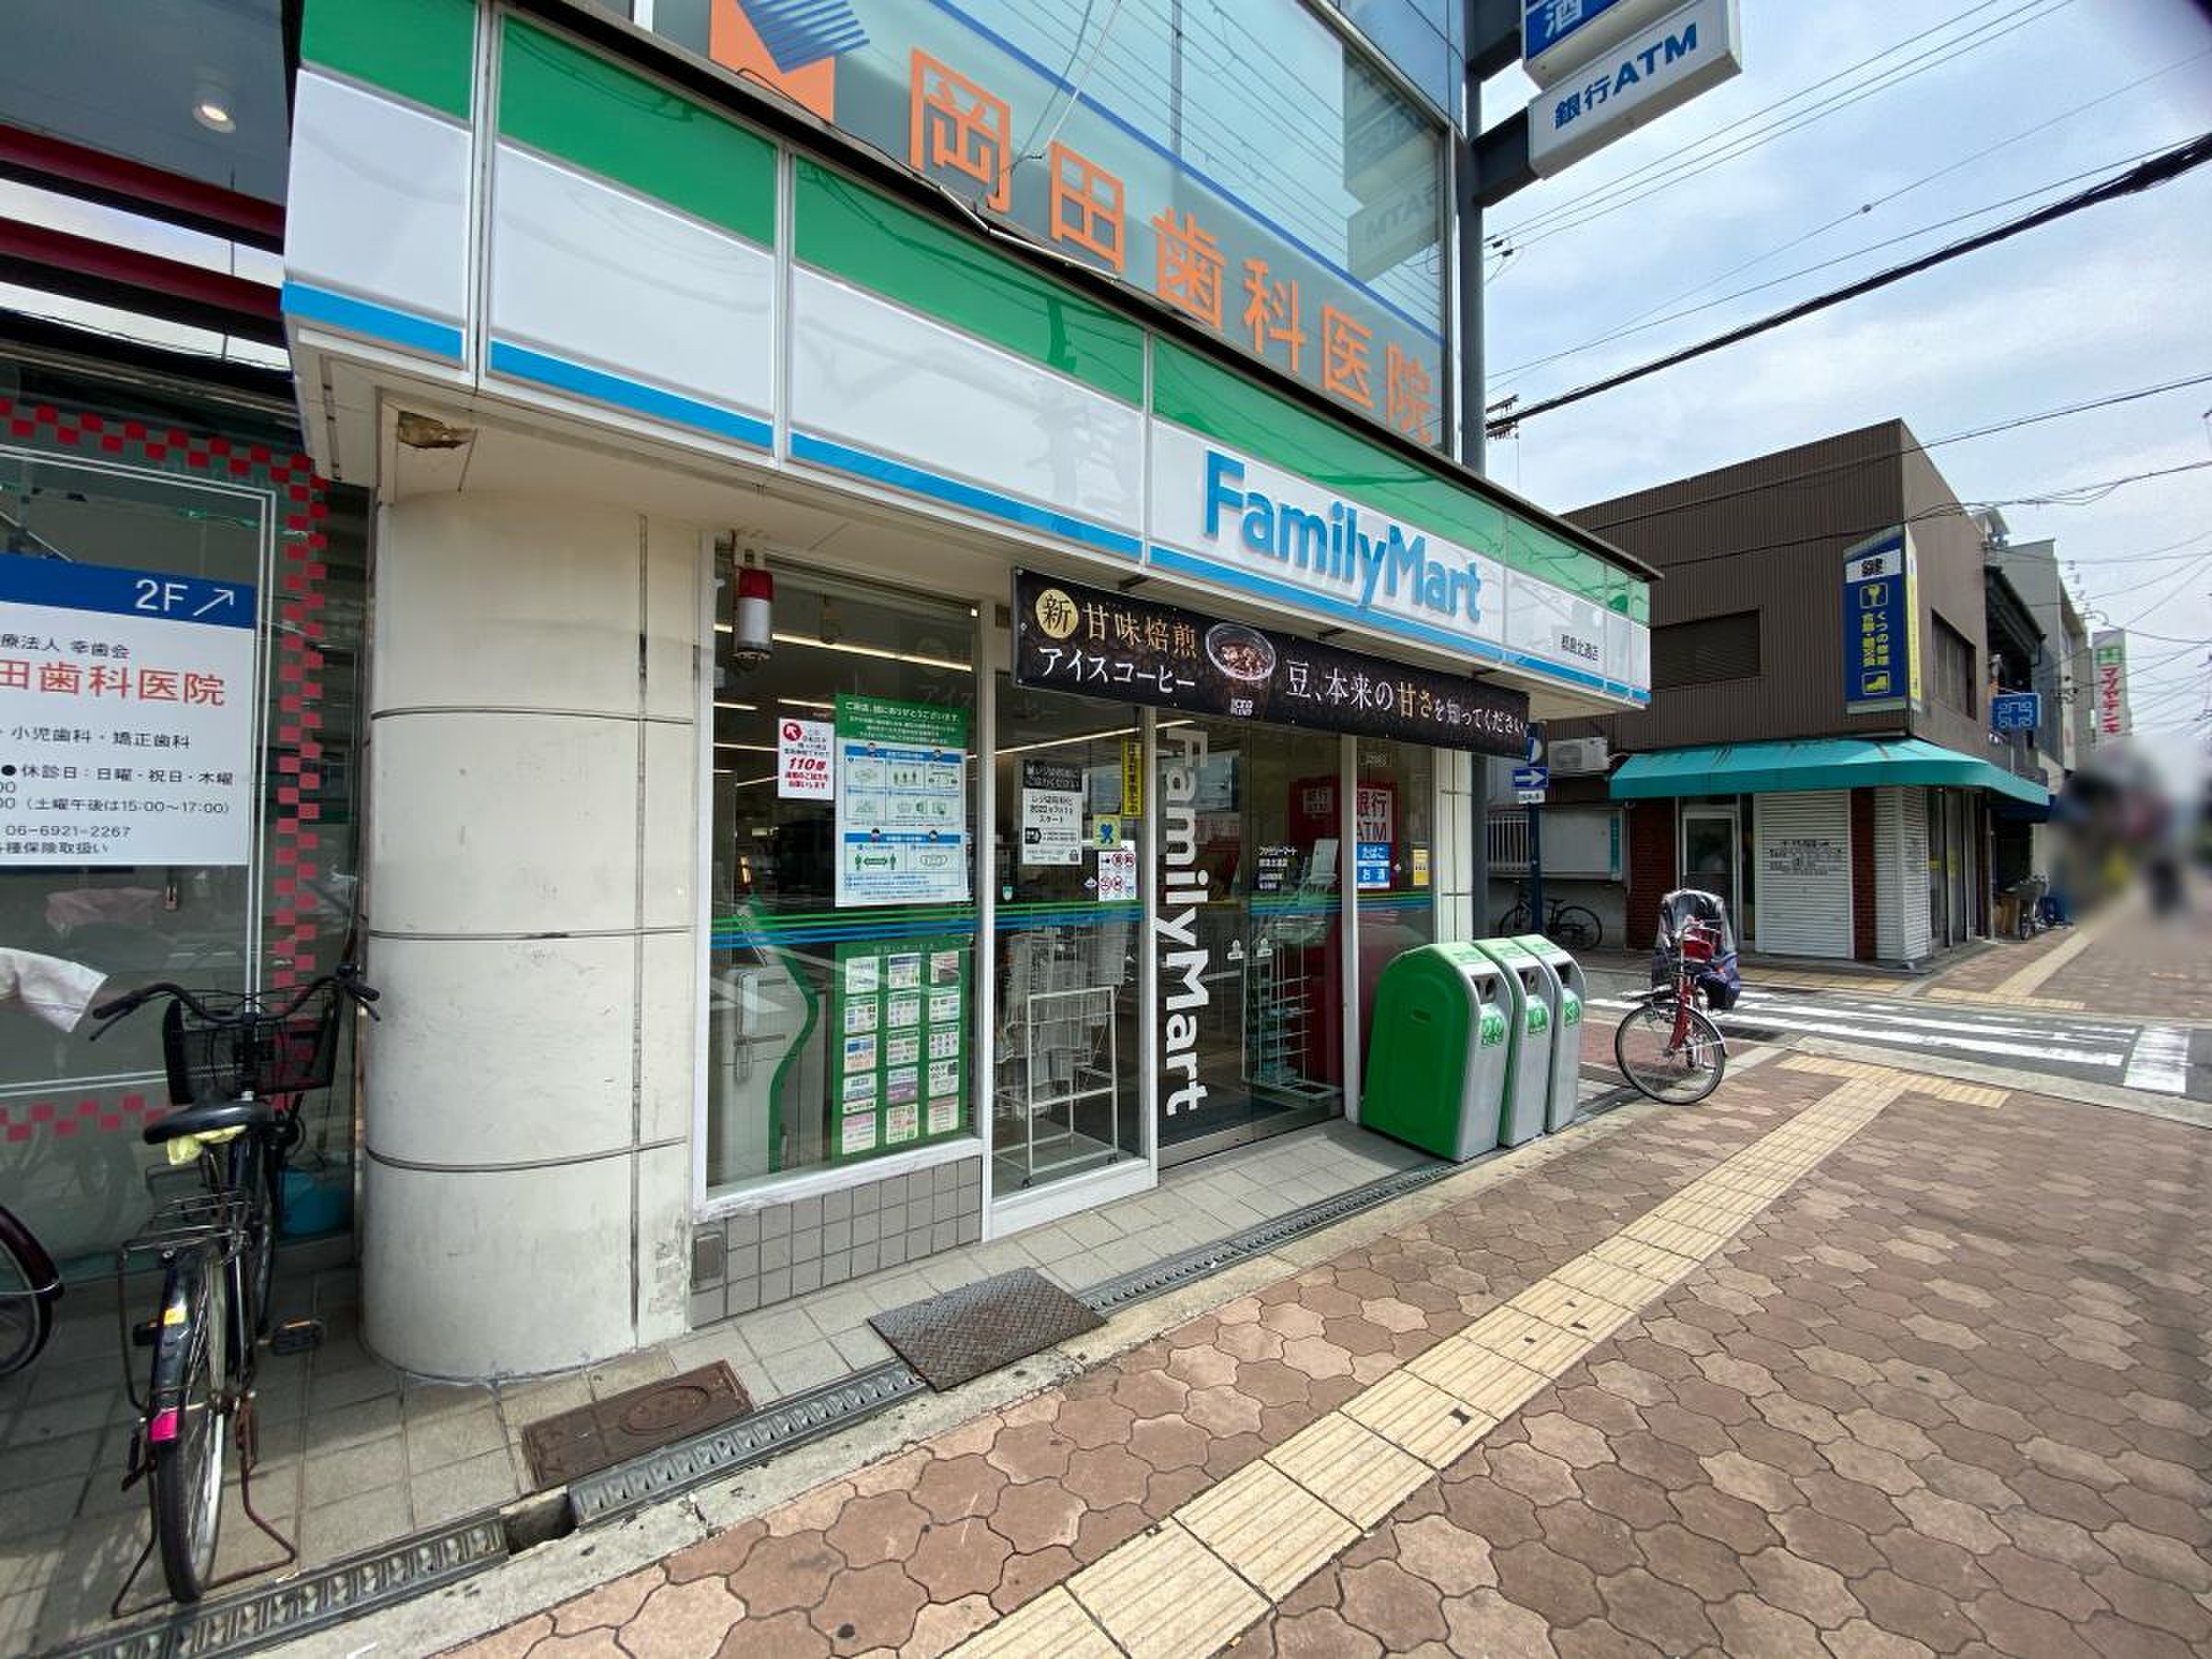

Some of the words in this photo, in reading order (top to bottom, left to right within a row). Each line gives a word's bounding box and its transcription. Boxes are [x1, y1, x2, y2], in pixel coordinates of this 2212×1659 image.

[1554, 22, 1698, 130] 銀行ATM
[909, 47, 1434, 444] 岡田歯科医院
[1202, 450, 1483, 622] FamilyMart
[135, 579, 189, 611] 2F
[1043, 594, 1073, 633] 新
[1082, 602, 1197, 658] 甘味焙煎
[0, 659, 225, 706] 田歯科医院
[1039, 648, 1195, 693] アイスコーヒー
[0, 841, 108, 854] 種保険取扱い
[1357, 821, 1387, 841] ATM
[1156, 729, 1209, 1117] FamilyMart
